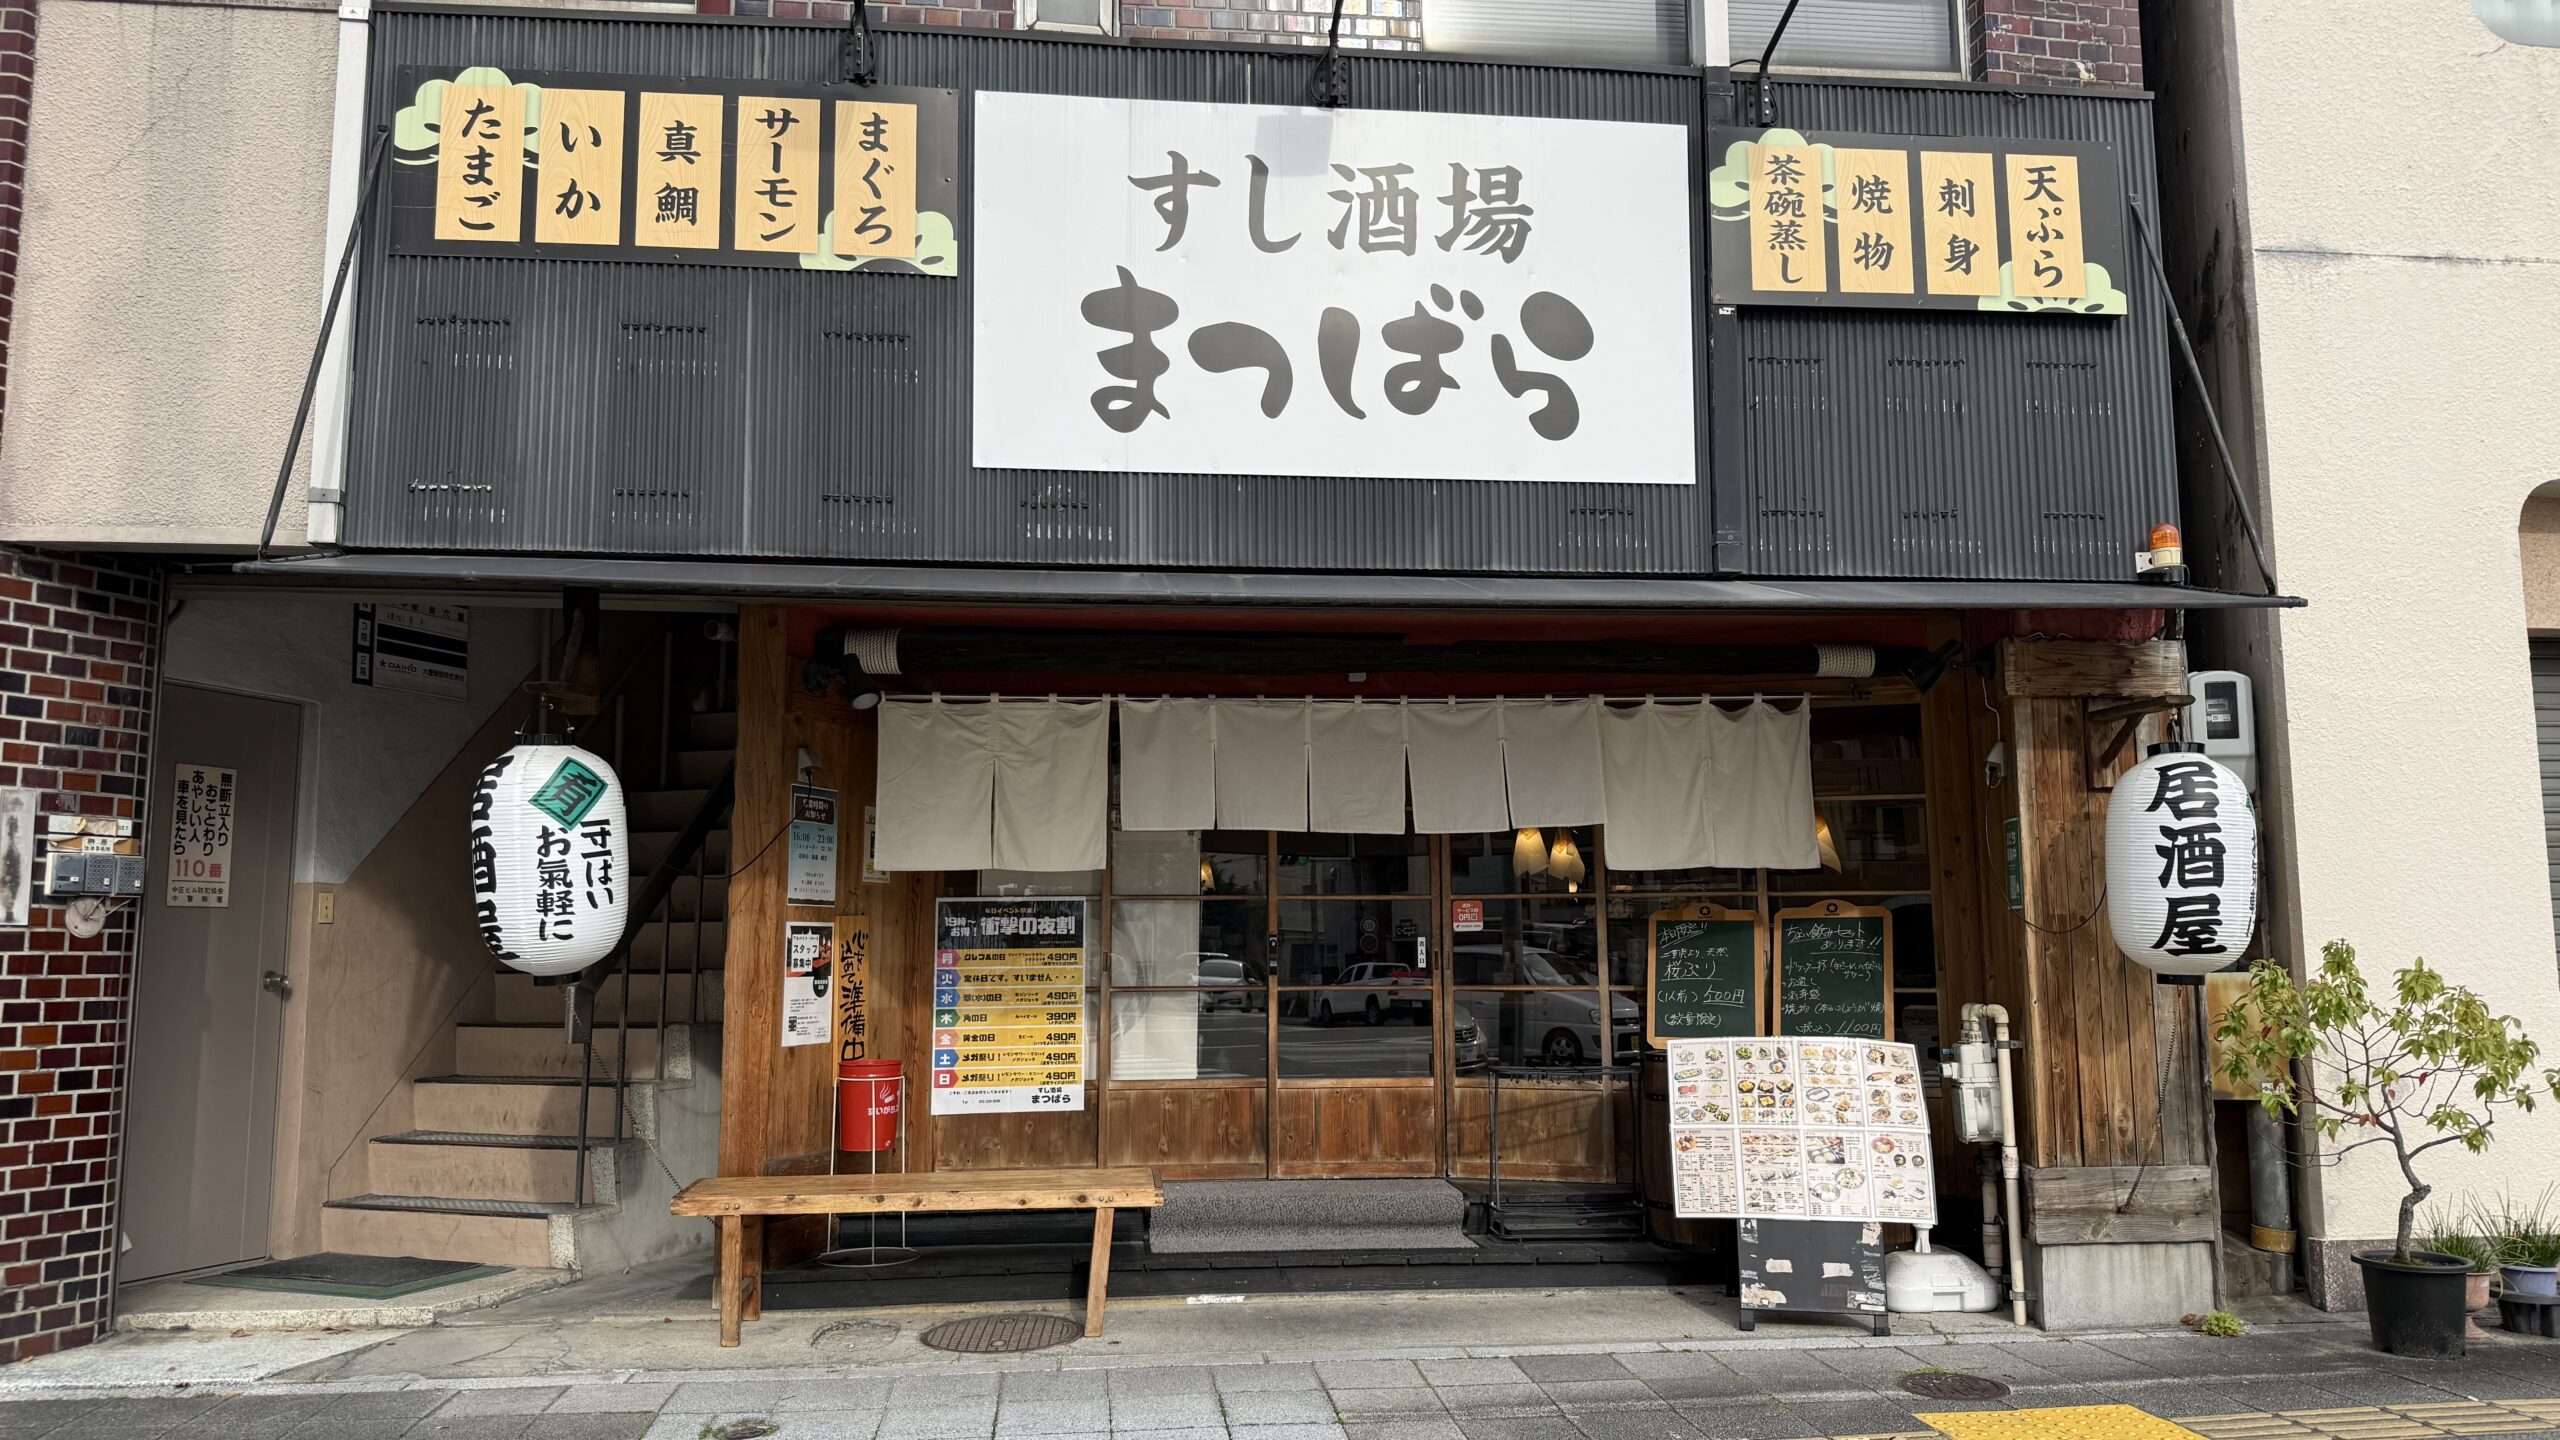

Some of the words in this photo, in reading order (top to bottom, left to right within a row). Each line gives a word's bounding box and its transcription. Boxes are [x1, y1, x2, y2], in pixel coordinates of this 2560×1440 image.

[459, 97, 502, 231] たまご
[556, 121, 601, 220] いか
[655, 119, 701, 227] 真鯛
[754, 107, 800, 242] サーモン
[855, 112, 895, 246] まぐろ
[1127, 149, 1535, 264] すし酒場
[1763, 154, 1808, 284] 茶碗蒸し
[1851, 174, 1895, 272] 焼物
[1938, 178, 1981, 277] 刺身
[2024, 165, 2066, 289] 天ぷら
[1080, 264, 1595, 442] まつばら
[549, 770, 598, 817] 肴
[189, 770, 205, 843] あやしい人
[217, 772, 233, 847] 無断立入り
[174, 780, 190, 856] 車を見たら
[203, 784, 218, 857] おことわり
[175, 858, 223, 878] 110番
[2144, 760, 2228, 957] 居酒屋
[980, 916, 1077, 936] 衝撃の夜割
[793, 944, 818, 954] スタッフ
[942, 953, 952, 964] 月
[1047, 952, 1078, 961] 490円
[941, 973, 953, 984] 火
[941, 993, 953, 1004] 水
[1047, 991, 1078, 1000] 490円
[1703, 984, 1745, 1004] 500円
[940, 1013, 952, 1024] 木
[1046, 1012, 1077, 1021] 390円
[940, 1033, 952, 1044] 金
[1046, 1032, 1077, 1041] 490円
[939, 1054, 951, 1065] 土
[1045, 1052, 1076, 1061] 490円
[939, 1074, 951, 1084] 日
[1045, 1072, 1076, 1080] 490円
[1031, 1094, 1071, 1104] まつばら
